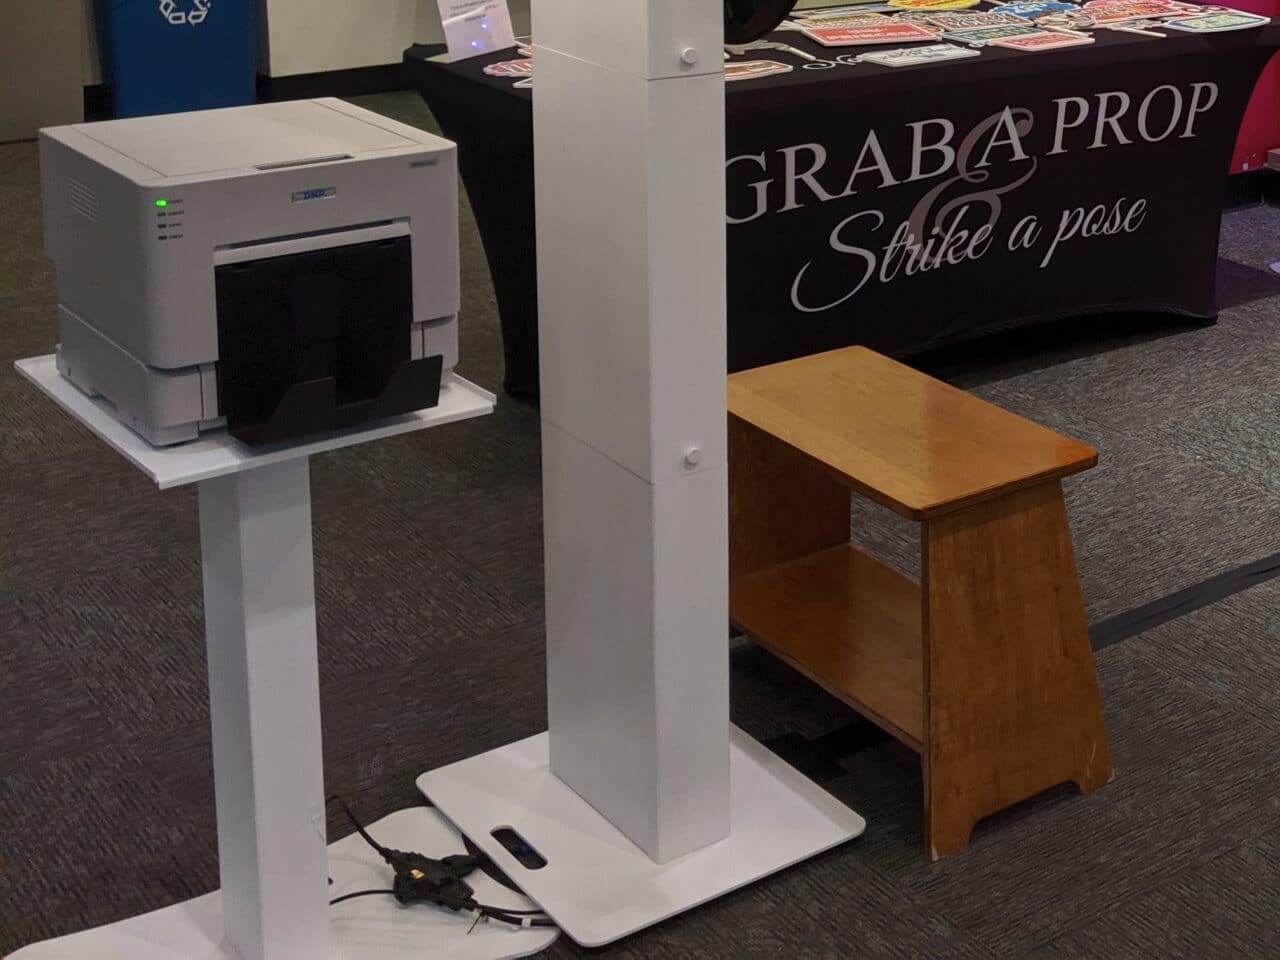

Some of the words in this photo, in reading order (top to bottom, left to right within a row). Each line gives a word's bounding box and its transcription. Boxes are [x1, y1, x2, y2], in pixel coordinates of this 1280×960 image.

[724, 119, 956, 224] GRAB
[977, 105, 1032, 168] A
[1045, 81, 1220, 157] PROP
[790, 205, 994, 313] Strike
[1008, 213, 1046, 251] a
[1039, 195, 1147, 269] pose
